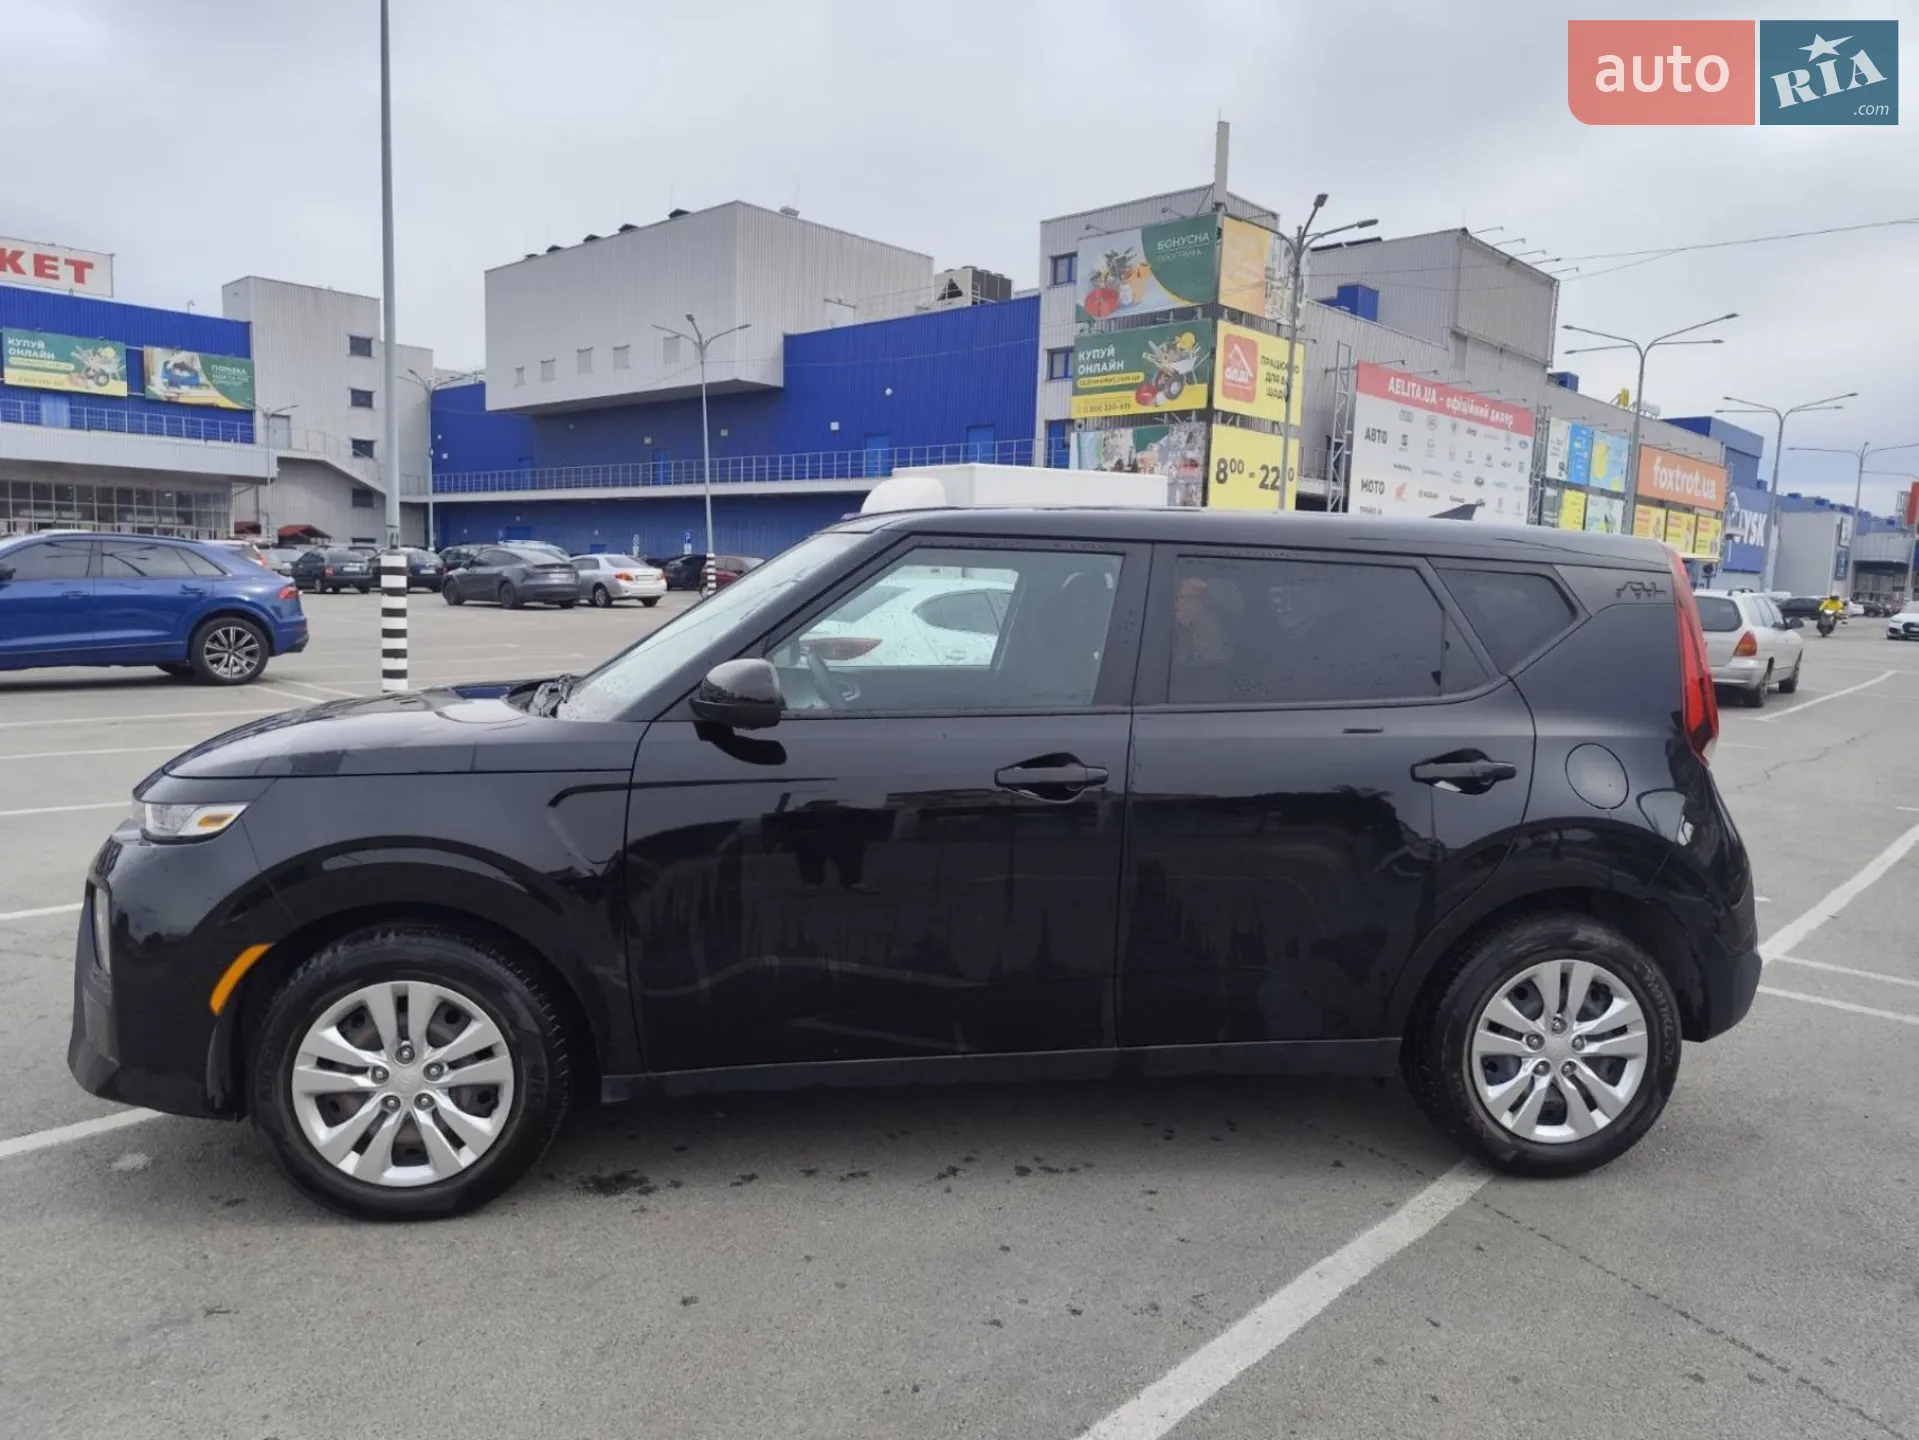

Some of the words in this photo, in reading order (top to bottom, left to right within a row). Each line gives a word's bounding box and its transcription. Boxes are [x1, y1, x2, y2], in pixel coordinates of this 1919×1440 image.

[1157, 232, 1210, 250] БОНУСНА
[1078, 344, 1115, 361] КУПУЙ
[1078, 359, 1124, 375] ОНЛАЙН
[1364, 426, 1388, 444] АВТО
[1653, 456, 1716, 501] foxtrot.ua
[1360, 479, 1385, 496] МОТО
